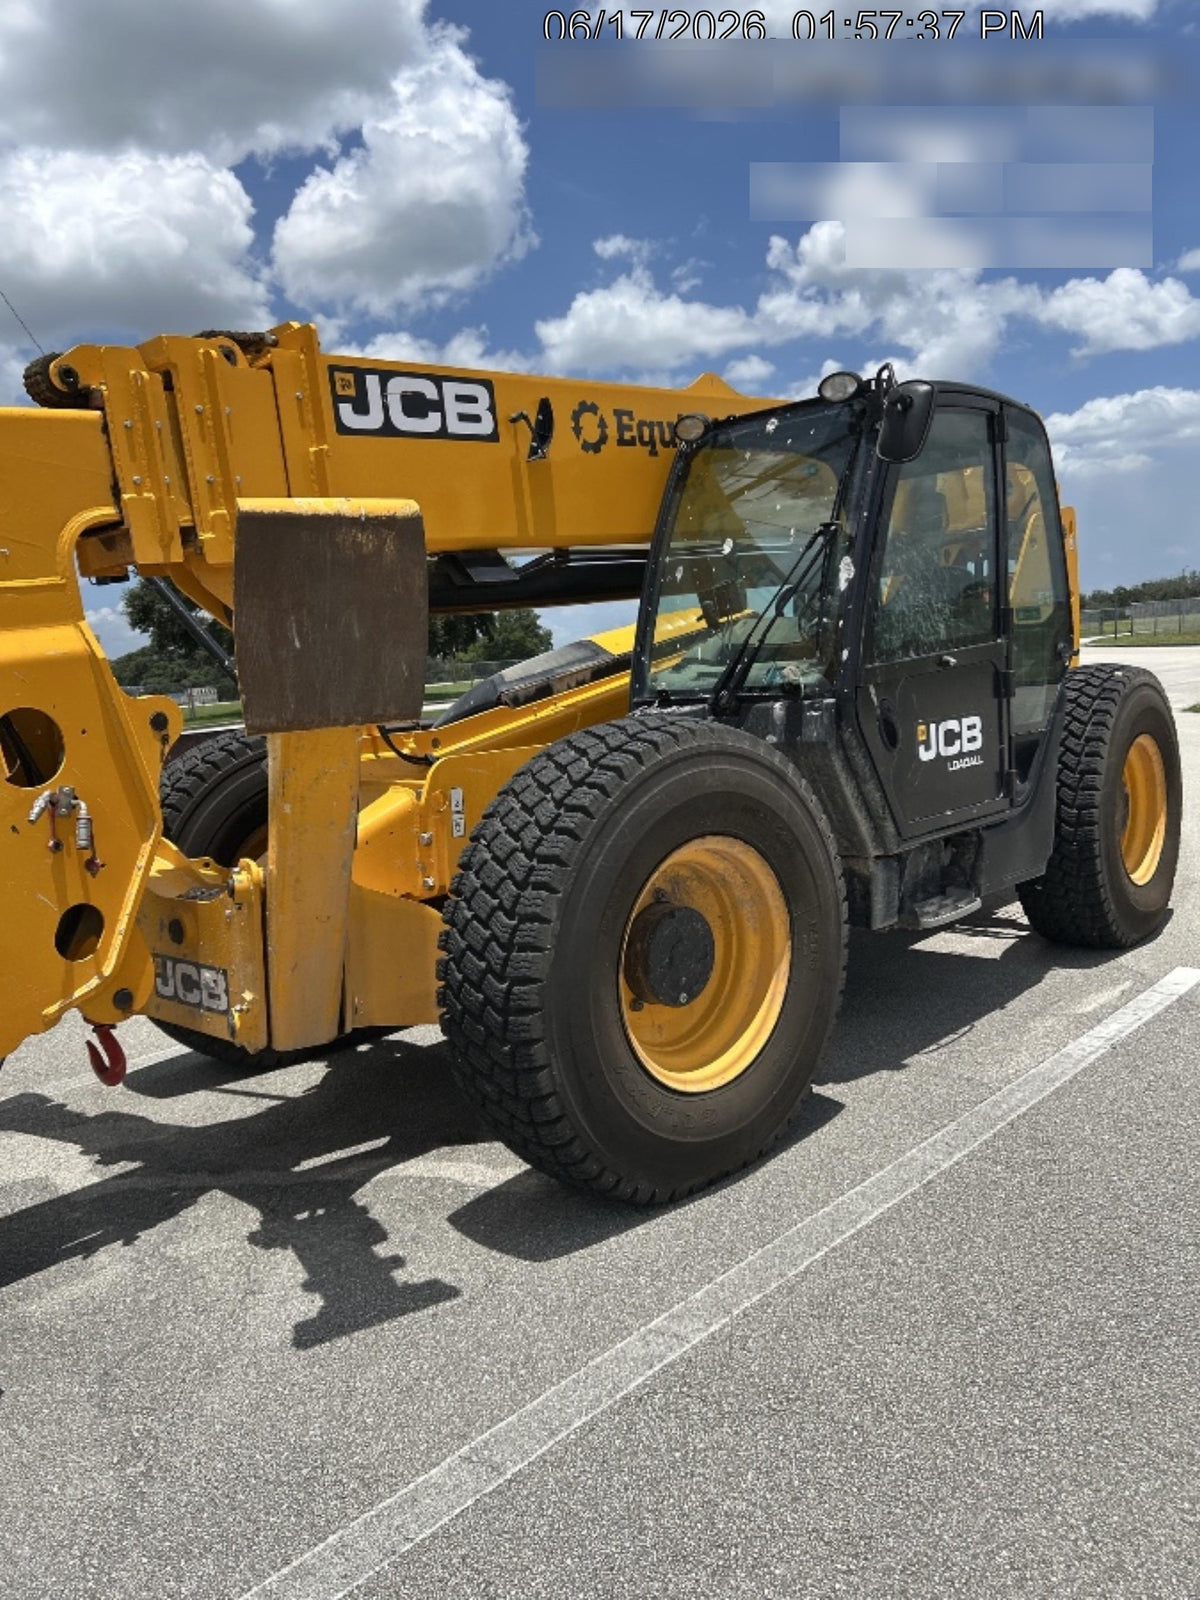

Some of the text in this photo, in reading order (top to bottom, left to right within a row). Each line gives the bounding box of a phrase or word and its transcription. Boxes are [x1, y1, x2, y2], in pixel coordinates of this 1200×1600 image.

[337, 375, 495, 434] JCB
[613, 408, 684, 456] Equ
[918, 716, 982, 761] JCB
[947, 755, 984, 771] LOADALL
[156, 960, 228, 1011] JCB
